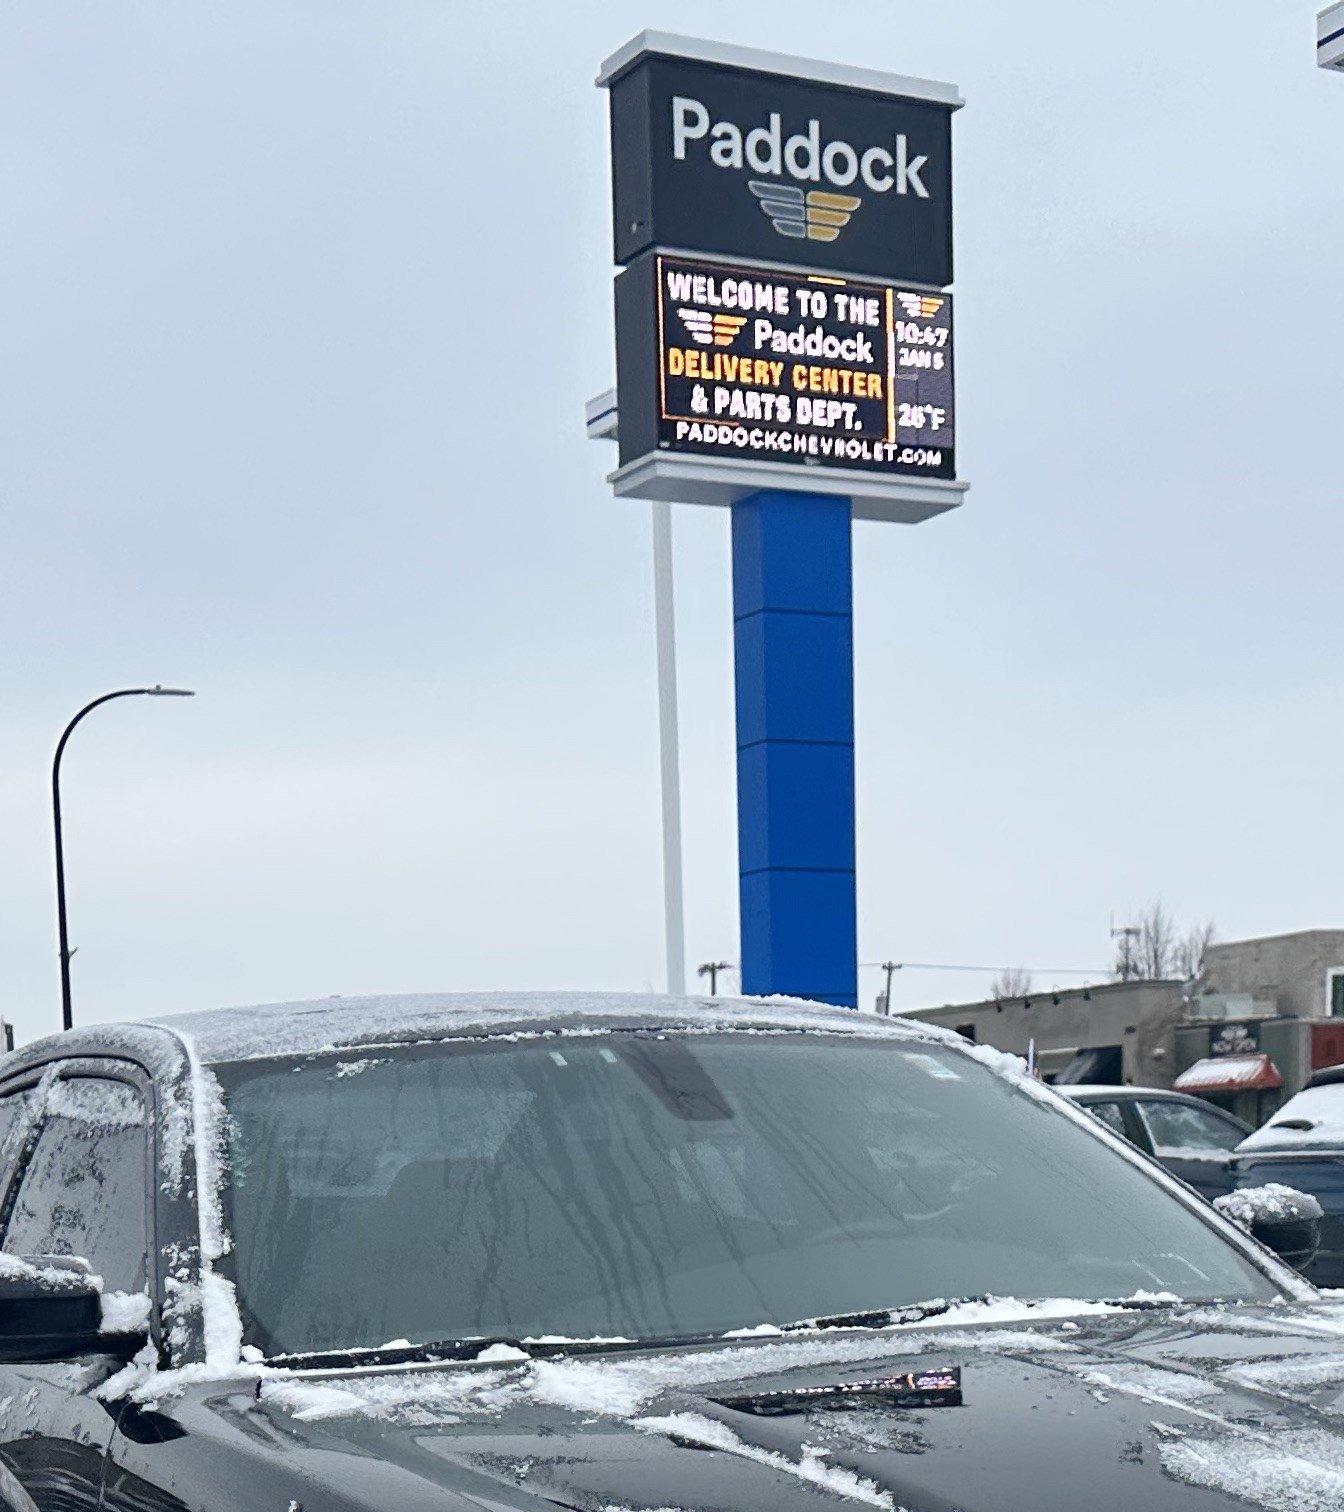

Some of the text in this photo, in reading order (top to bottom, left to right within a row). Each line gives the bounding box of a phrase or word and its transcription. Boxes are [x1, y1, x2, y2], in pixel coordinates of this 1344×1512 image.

[671, 95, 930, 199] Paddock
[666, 271, 880, 327] WELCOME TO THE
[754, 318, 874, 364] Paddock
[895, 320, 949, 347] 10:47
[668, 347, 883, 399] DELIVERY CENTER
[899, 347, 931, 369] JAN
[690, 383, 863, 431] & PARTS DEPT.
[676, 420, 942, 467] PADDOCKCHEVROLET.COM
